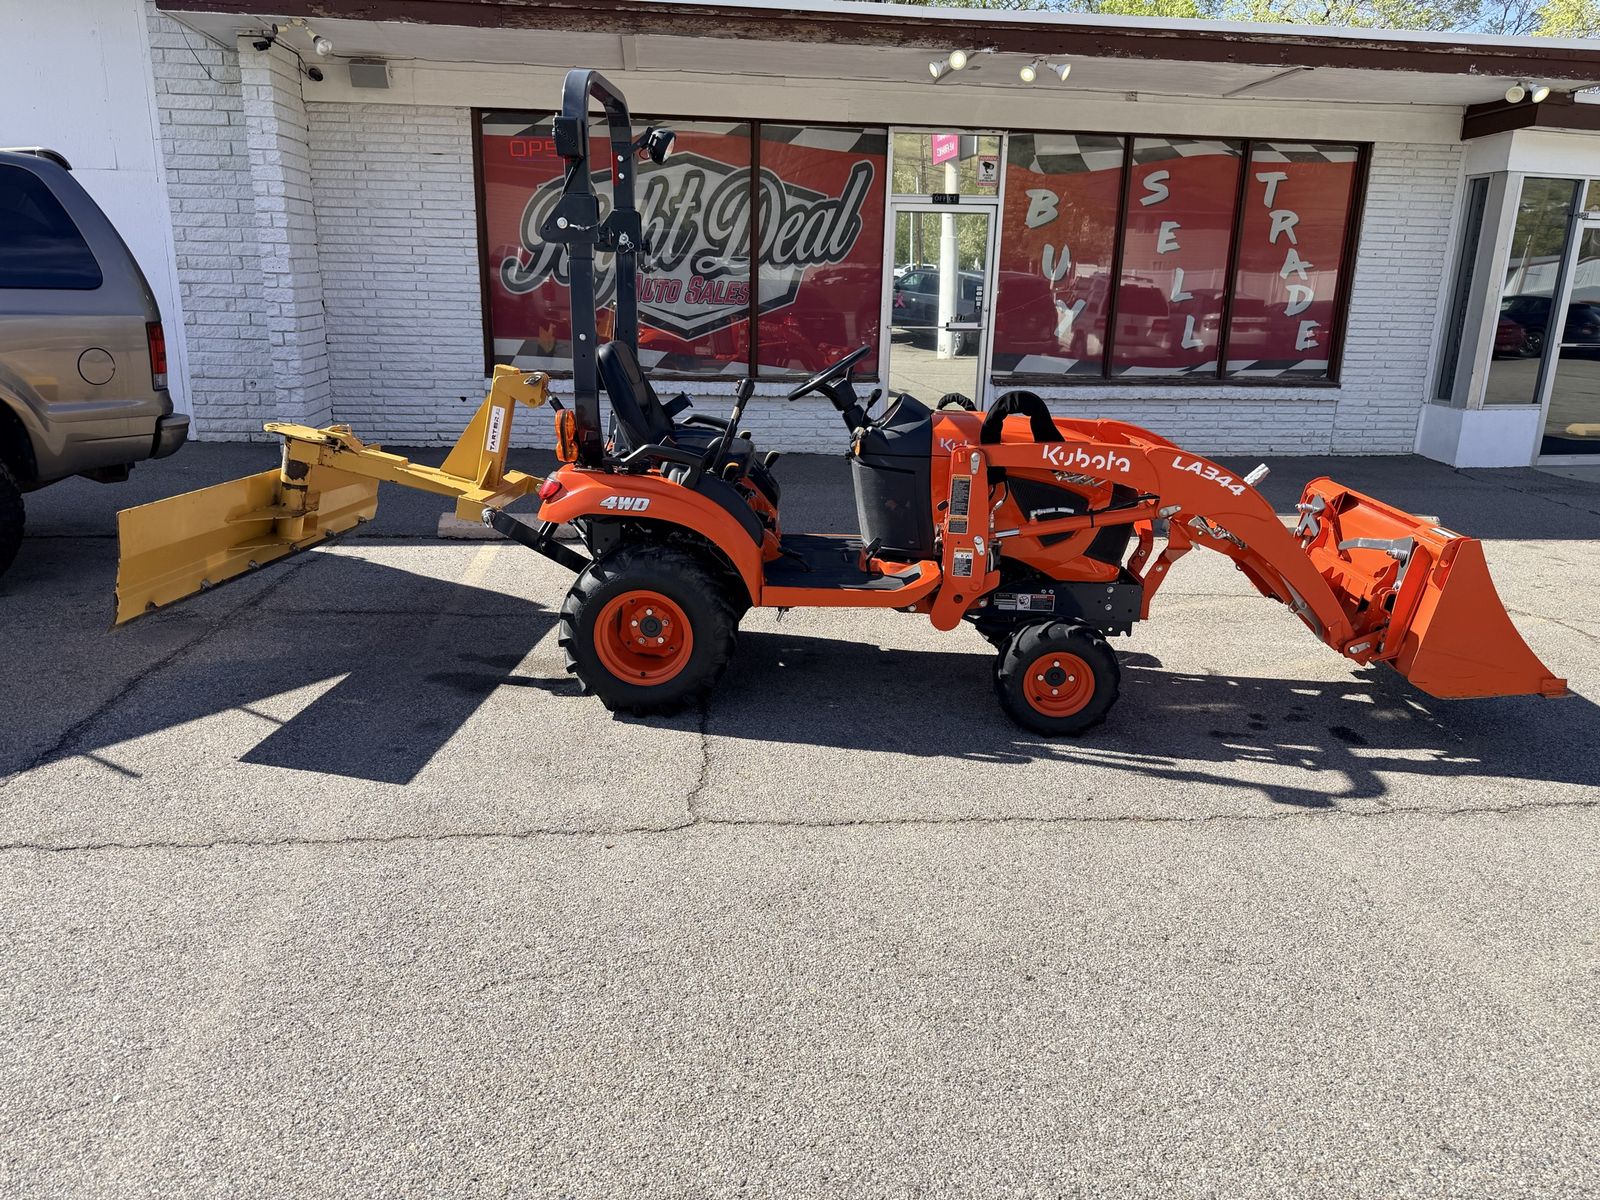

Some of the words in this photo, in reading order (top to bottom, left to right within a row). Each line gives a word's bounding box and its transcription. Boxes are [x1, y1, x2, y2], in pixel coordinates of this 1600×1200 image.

[688, 159, 876, 278] Deal
[1024, 188, 1087, 338] BUY
[1140, 169, 1203, 350] SELL
[1256, 171, 1320, 352] TRADE
[685, 275, 750, 305] SALES
[489, 416, 499, 451] TARTER
[1042, 444, 1131, 473] Kubota
[1172, 455, 1246, 496] LA344
[599, 495, 651, 511] 4WD
